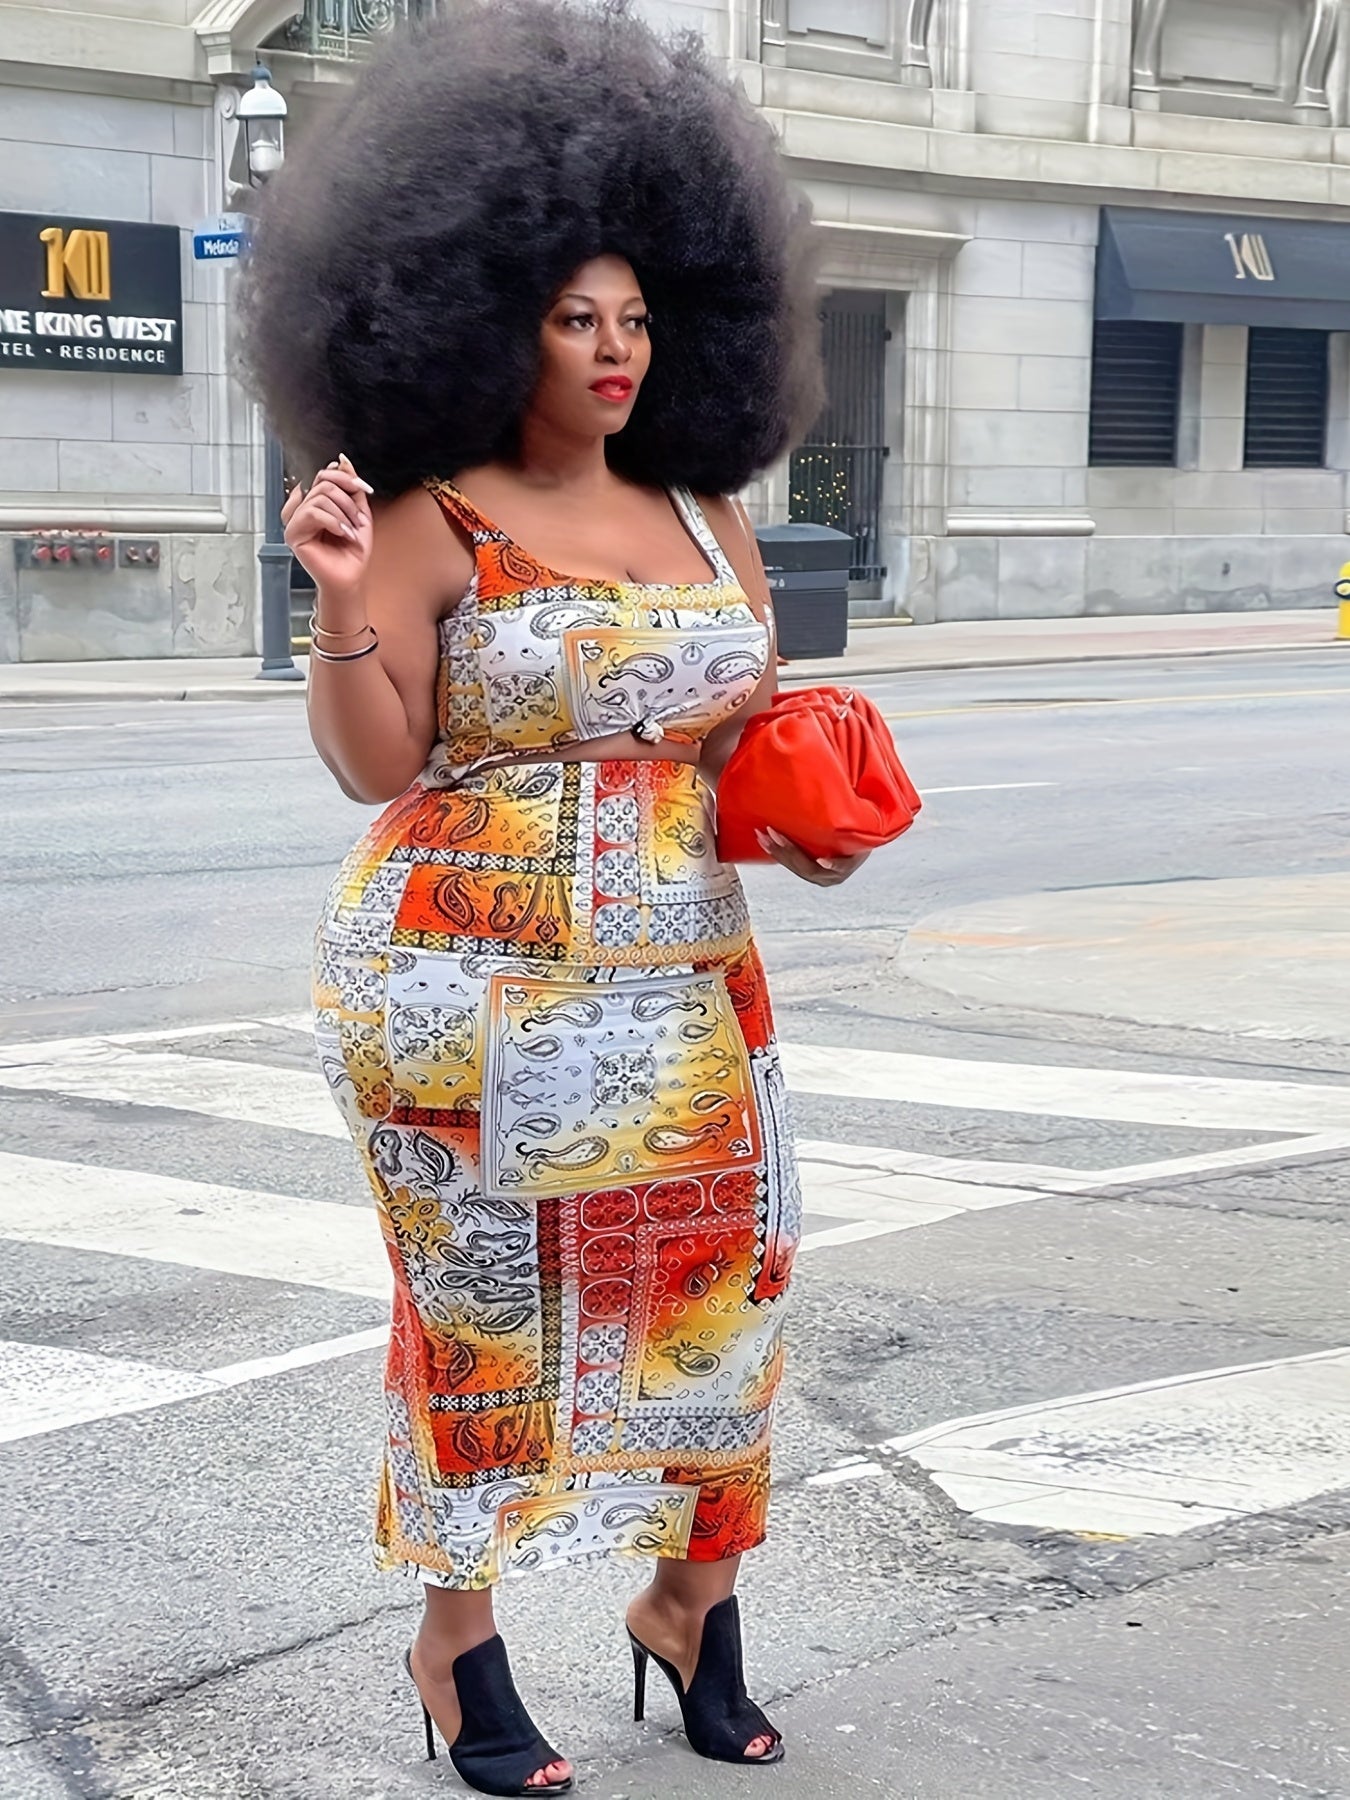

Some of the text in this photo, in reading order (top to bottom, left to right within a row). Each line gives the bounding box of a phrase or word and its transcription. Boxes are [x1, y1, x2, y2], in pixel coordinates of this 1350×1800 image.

[35, 311, 104, 338] KING
[107, 315, 176, 342] WEST
[0, 342, 165, 363] TEL RESIDENCE
